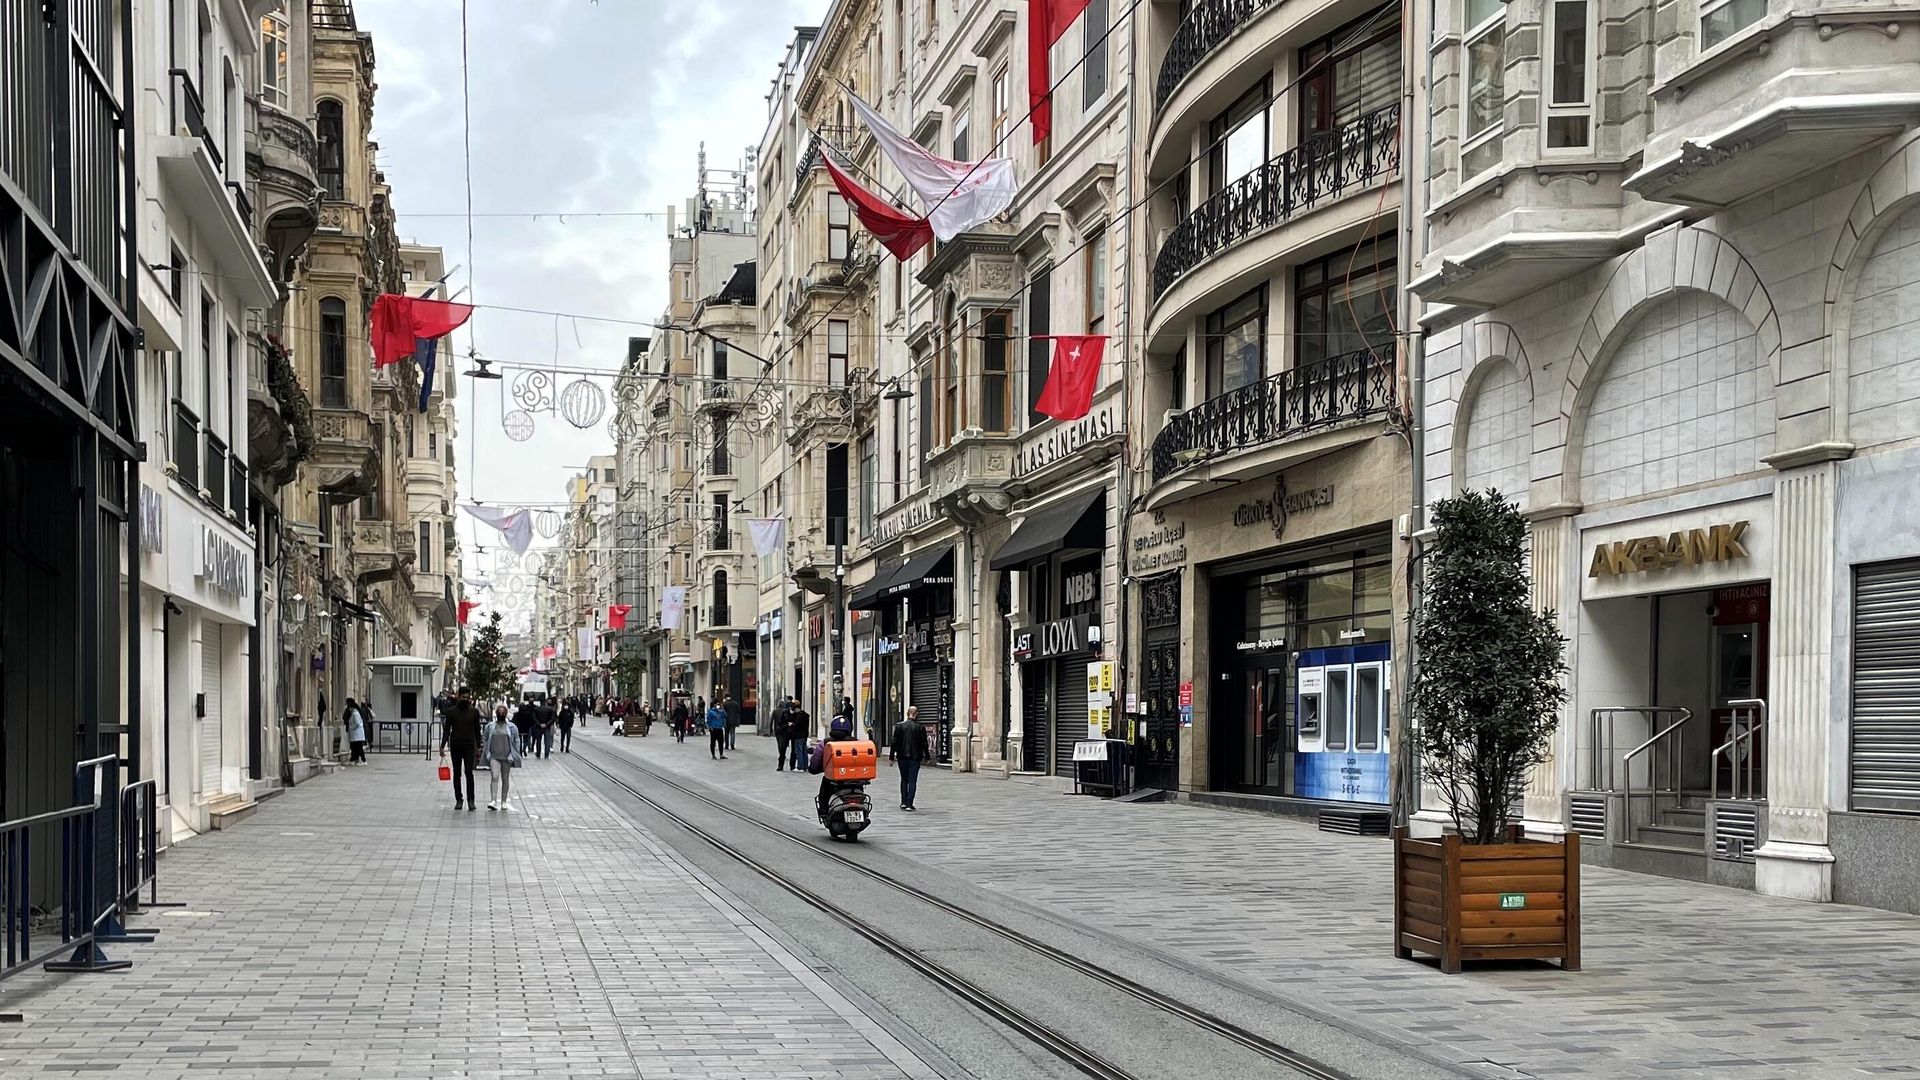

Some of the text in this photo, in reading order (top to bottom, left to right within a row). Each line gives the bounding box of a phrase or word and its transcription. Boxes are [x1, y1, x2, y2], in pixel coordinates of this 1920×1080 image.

[1010, 407, 1114, 478] ATLAS SİNEMASI
[1285, 485, 1334, 514] BANKASI
[1588, 520, 1751, 578] AKBANK
